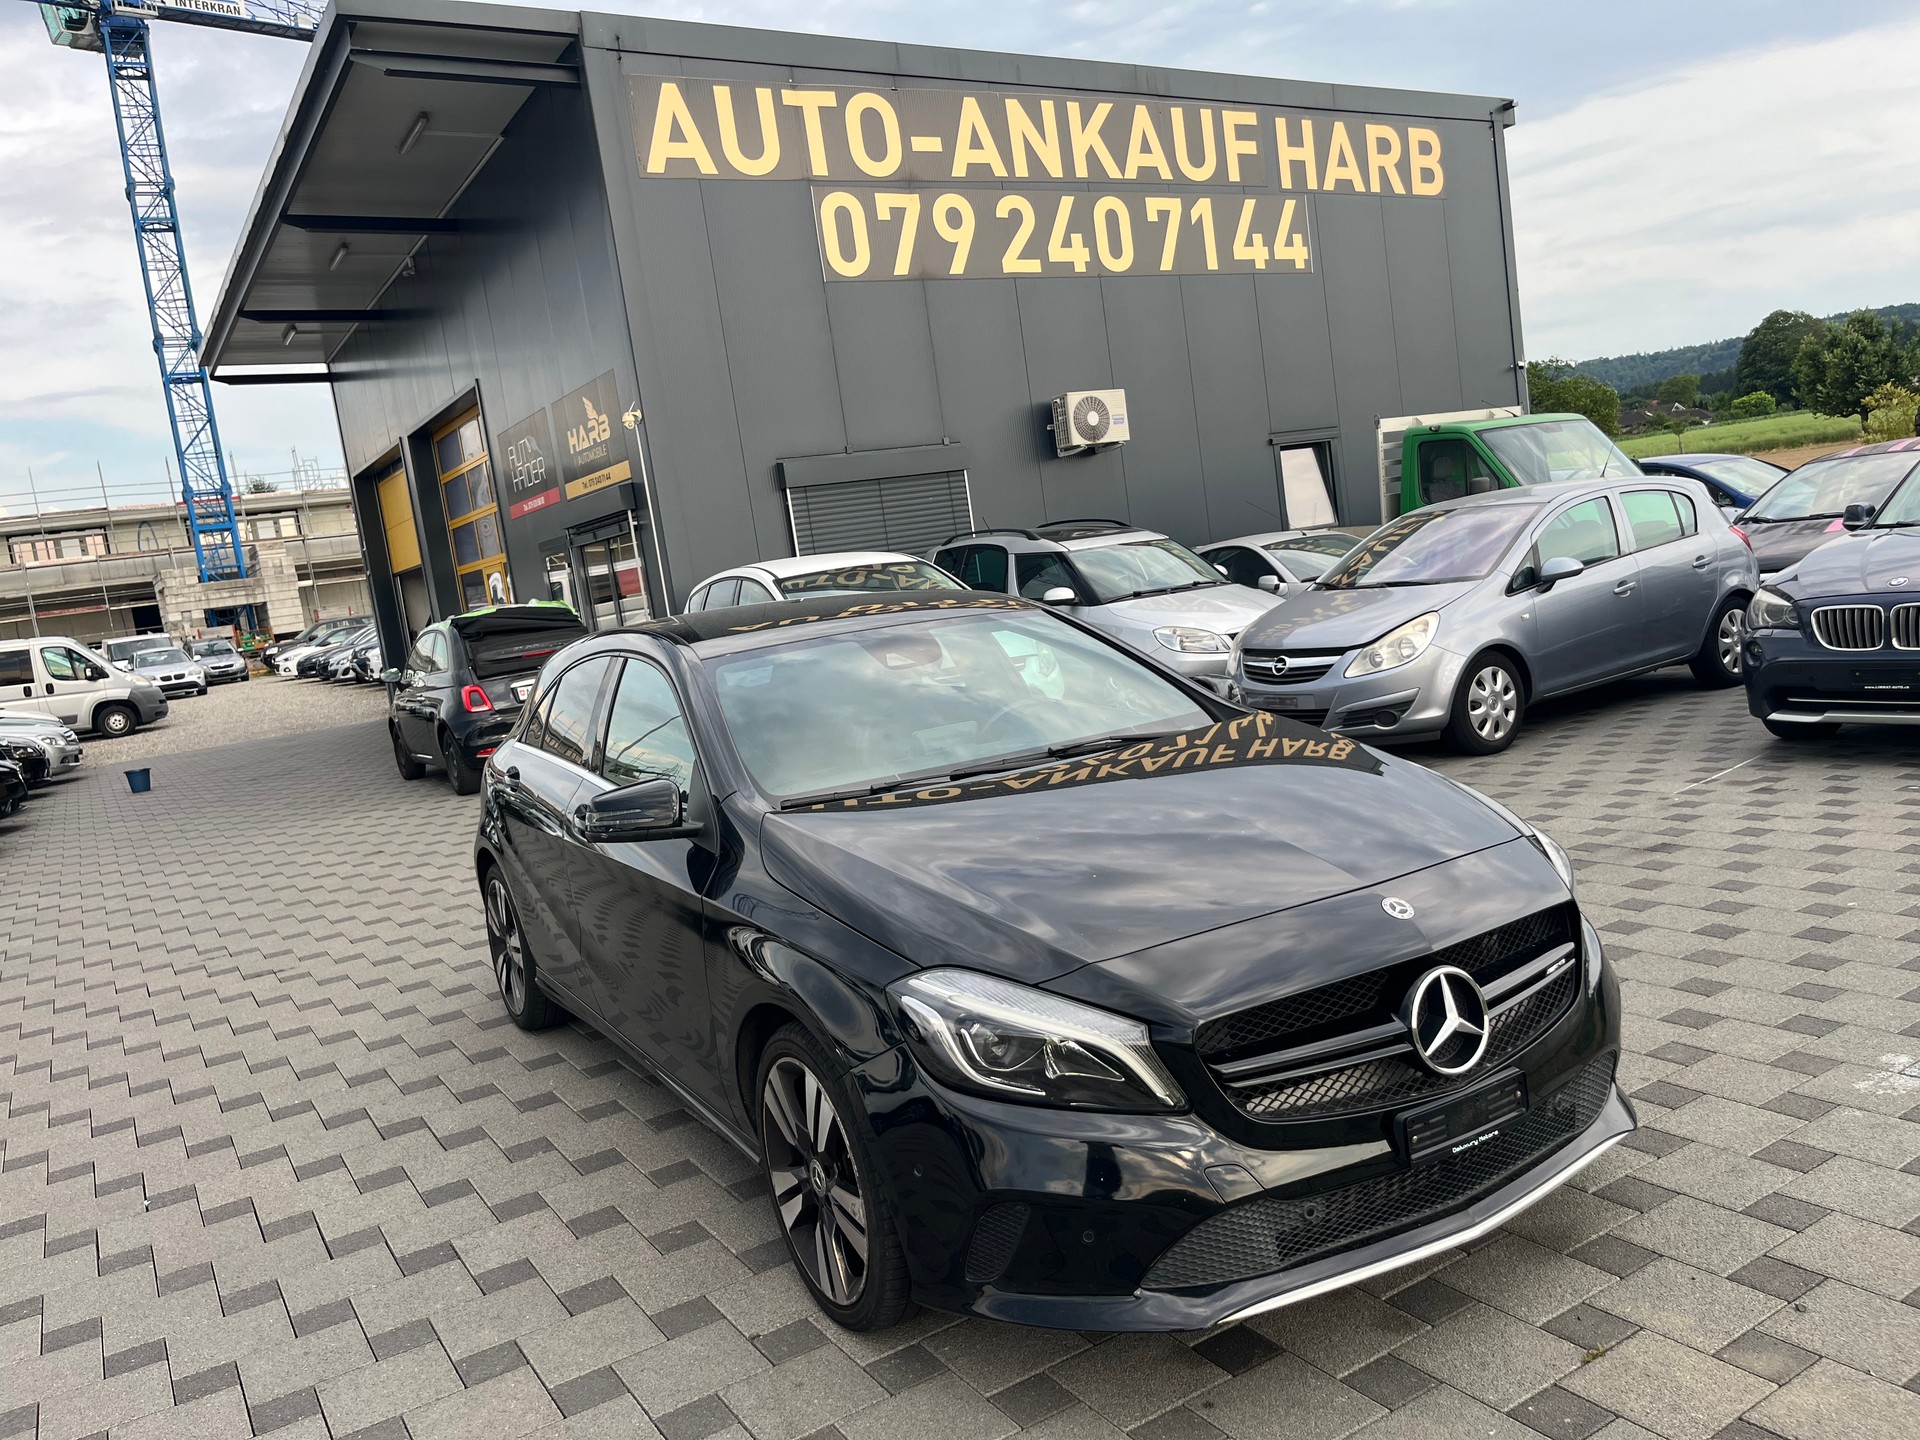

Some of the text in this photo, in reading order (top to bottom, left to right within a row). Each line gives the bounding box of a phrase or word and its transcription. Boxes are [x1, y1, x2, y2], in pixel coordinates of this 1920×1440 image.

[175, 0, 241, 16] INTERKRAN
[647, 82, 1444, 196] AUTO-ANKAUF HARB
[821, 191, 976, 277] 079
[996, 195, 1134, 273] 240
[567, 414, 610, 454] HARB
